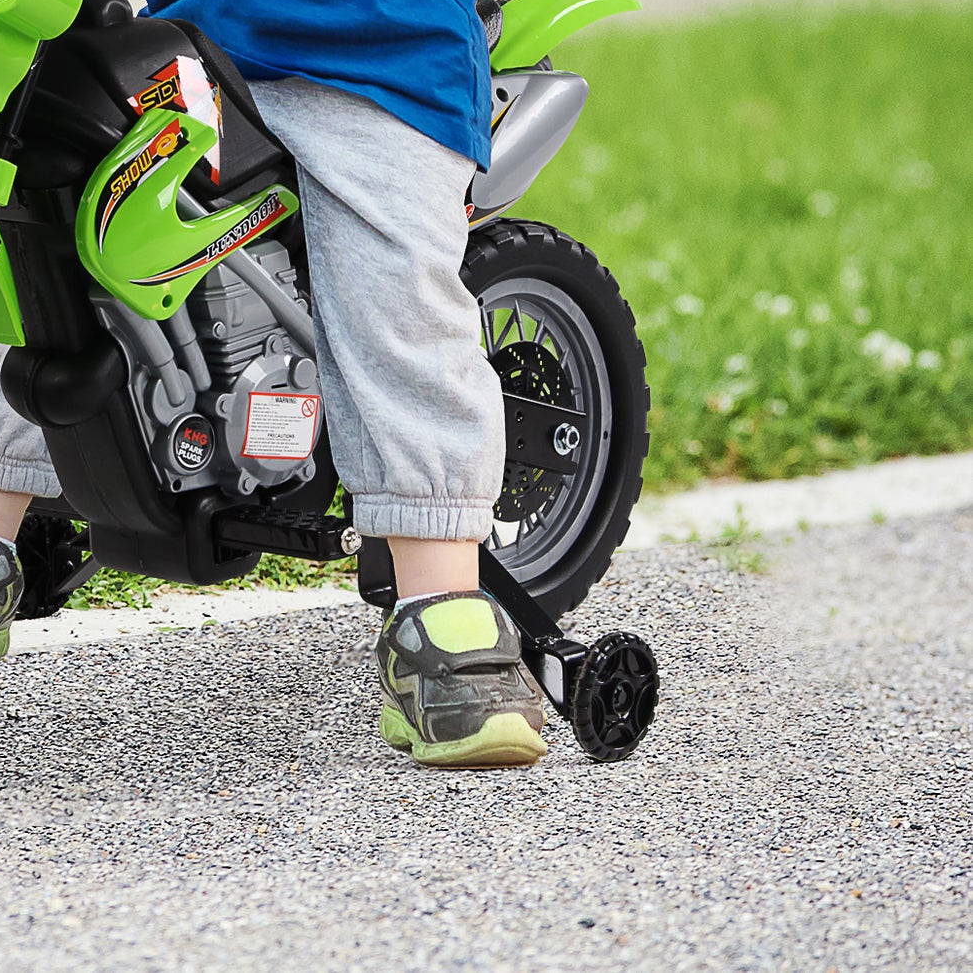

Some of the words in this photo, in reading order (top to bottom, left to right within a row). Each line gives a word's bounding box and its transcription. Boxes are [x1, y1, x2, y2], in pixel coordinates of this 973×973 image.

[110, 148, 153, 200] SHOW
[183, 427, 208, 446] KNG
[178, 449, 202, 463] PLUGS
[180, 441, 204, 456] SPARK
